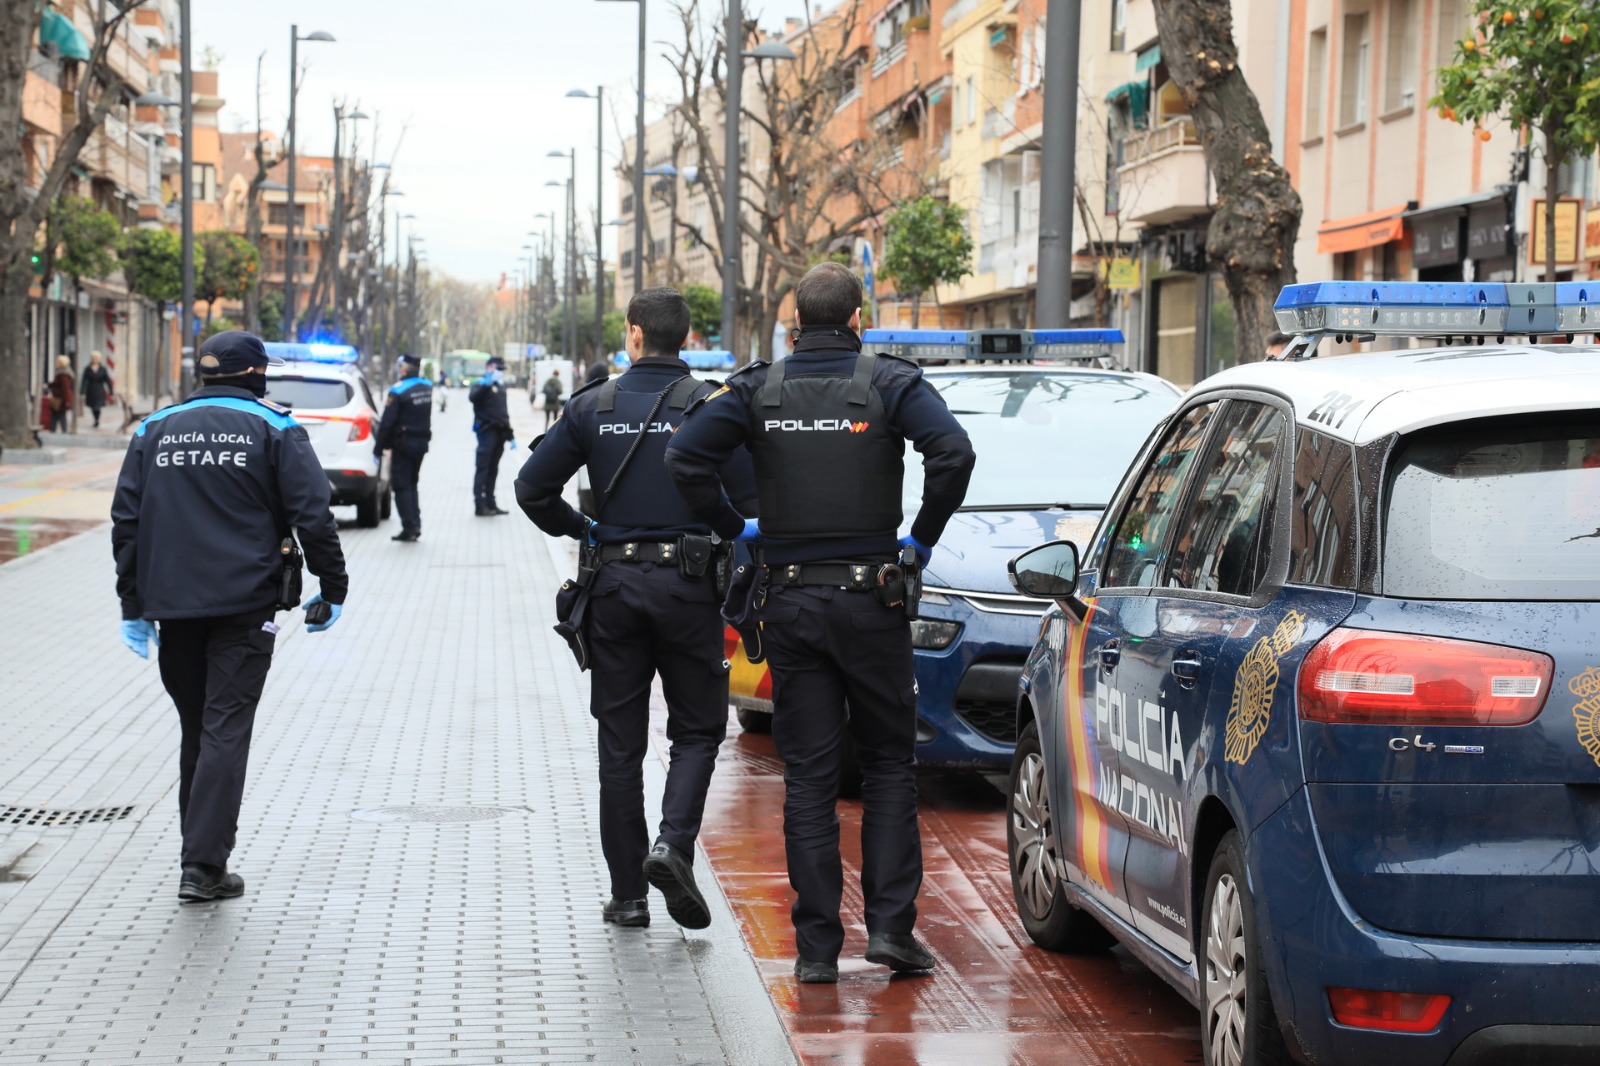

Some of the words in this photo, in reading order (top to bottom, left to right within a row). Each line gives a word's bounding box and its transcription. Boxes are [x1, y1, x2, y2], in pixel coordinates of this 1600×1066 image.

[1306, 390, 1365, 429] 2R1
[599, 422, 674, 435] POLICIA
[764, 419, 853, 431] POLICIA
[211, 433, 253, 444] LOCAL
[156, 450, 247, 467] GETAFE
[1096, 680, 1187, 782] POLICÍA
[1388, 735, 1436, 752] C4
[1099, 761, 1188, 858] NACIONAL
[1147, 896, 1187, 928] www.policia.es
